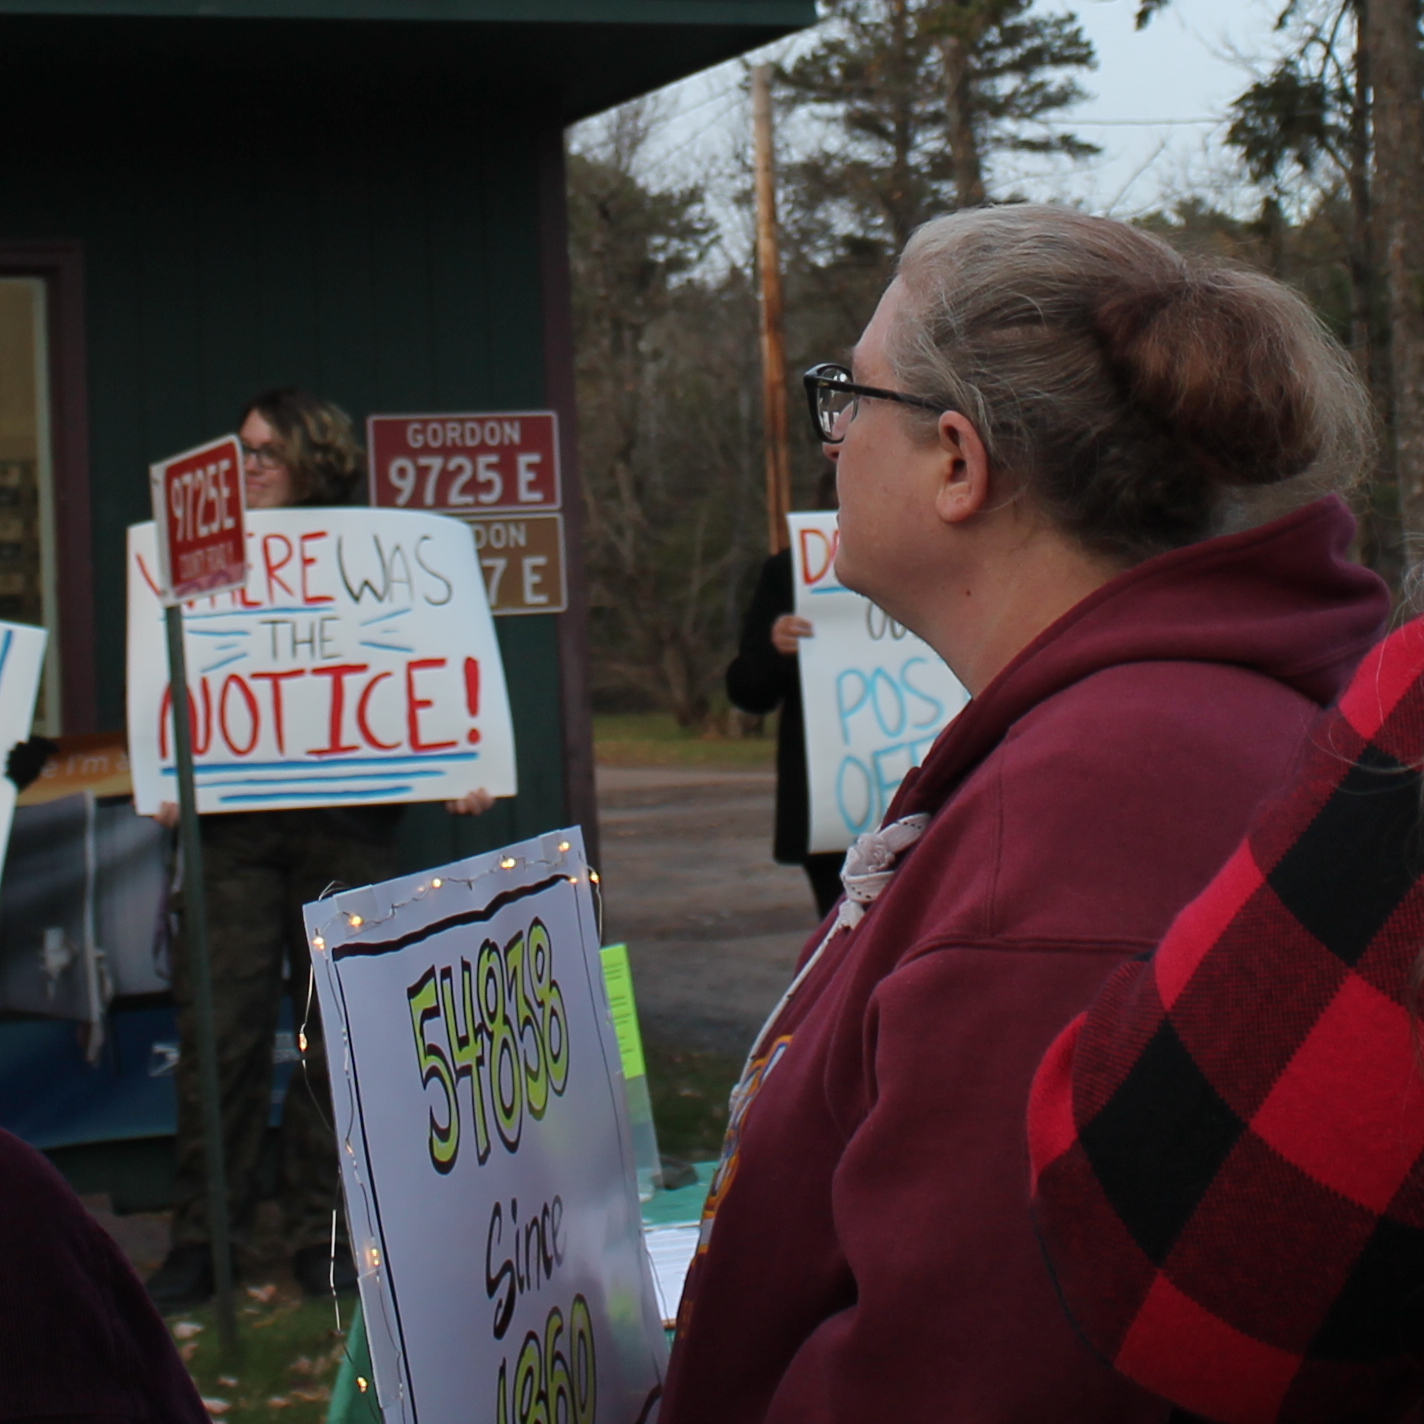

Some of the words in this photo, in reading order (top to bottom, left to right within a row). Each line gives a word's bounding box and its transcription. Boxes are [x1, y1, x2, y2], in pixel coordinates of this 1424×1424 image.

[406, 421, 521, 448] GORDON
[171, 458, 236, 543] 9725E
[388, 454, 504, 507] 9725
[517, 453, 544, 502] E
[337, 534, 453, 606] WAS
[521, 555, 550, 604] E
[259, 616, 343, 662] THE
[159, 657, 482, 761] NOTICE!
[836, 656, 973, 746] POS
[406, 916, 570, 1176] 54838
[485, 1194, 567, 1341] Since
